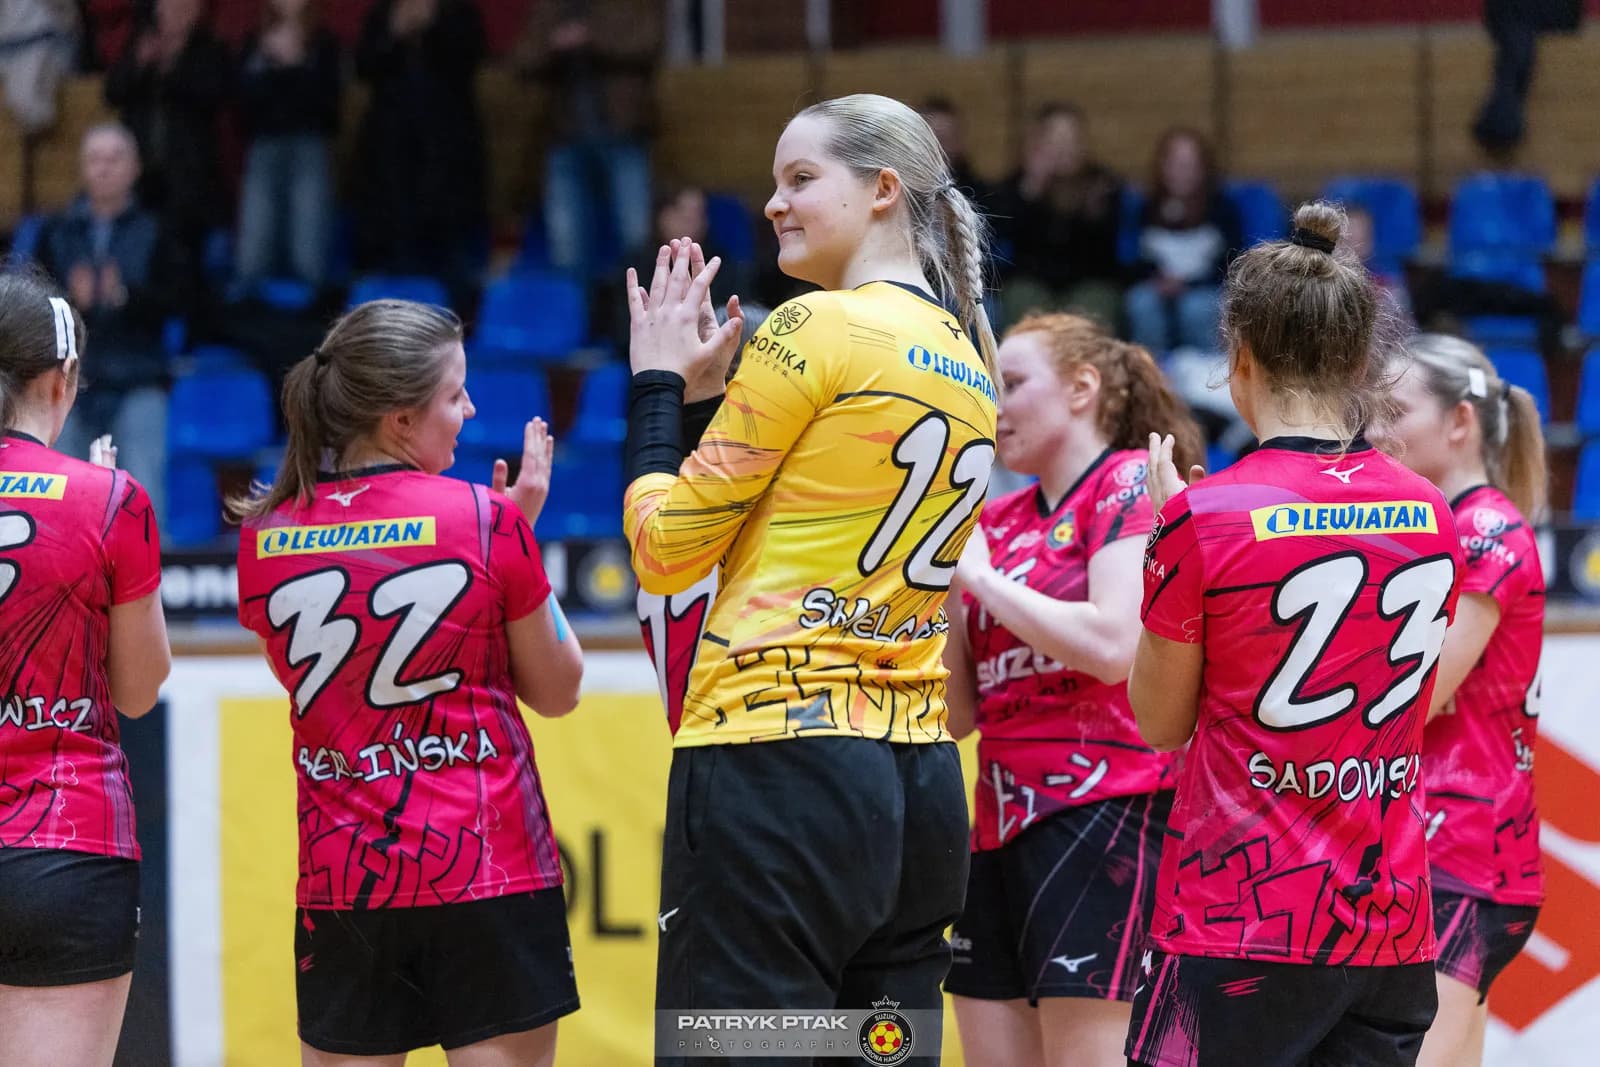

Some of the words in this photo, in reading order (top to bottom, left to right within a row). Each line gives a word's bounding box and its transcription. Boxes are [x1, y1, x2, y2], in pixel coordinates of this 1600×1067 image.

[290, 522, 423, 550] LEWIATAN
[858, 410, 995, 591] 12
[1303, 504, 1427, 530] LEWIATAN
[266, 558, 474, 720] 32
[1252, 550, 1455, 734] 23
